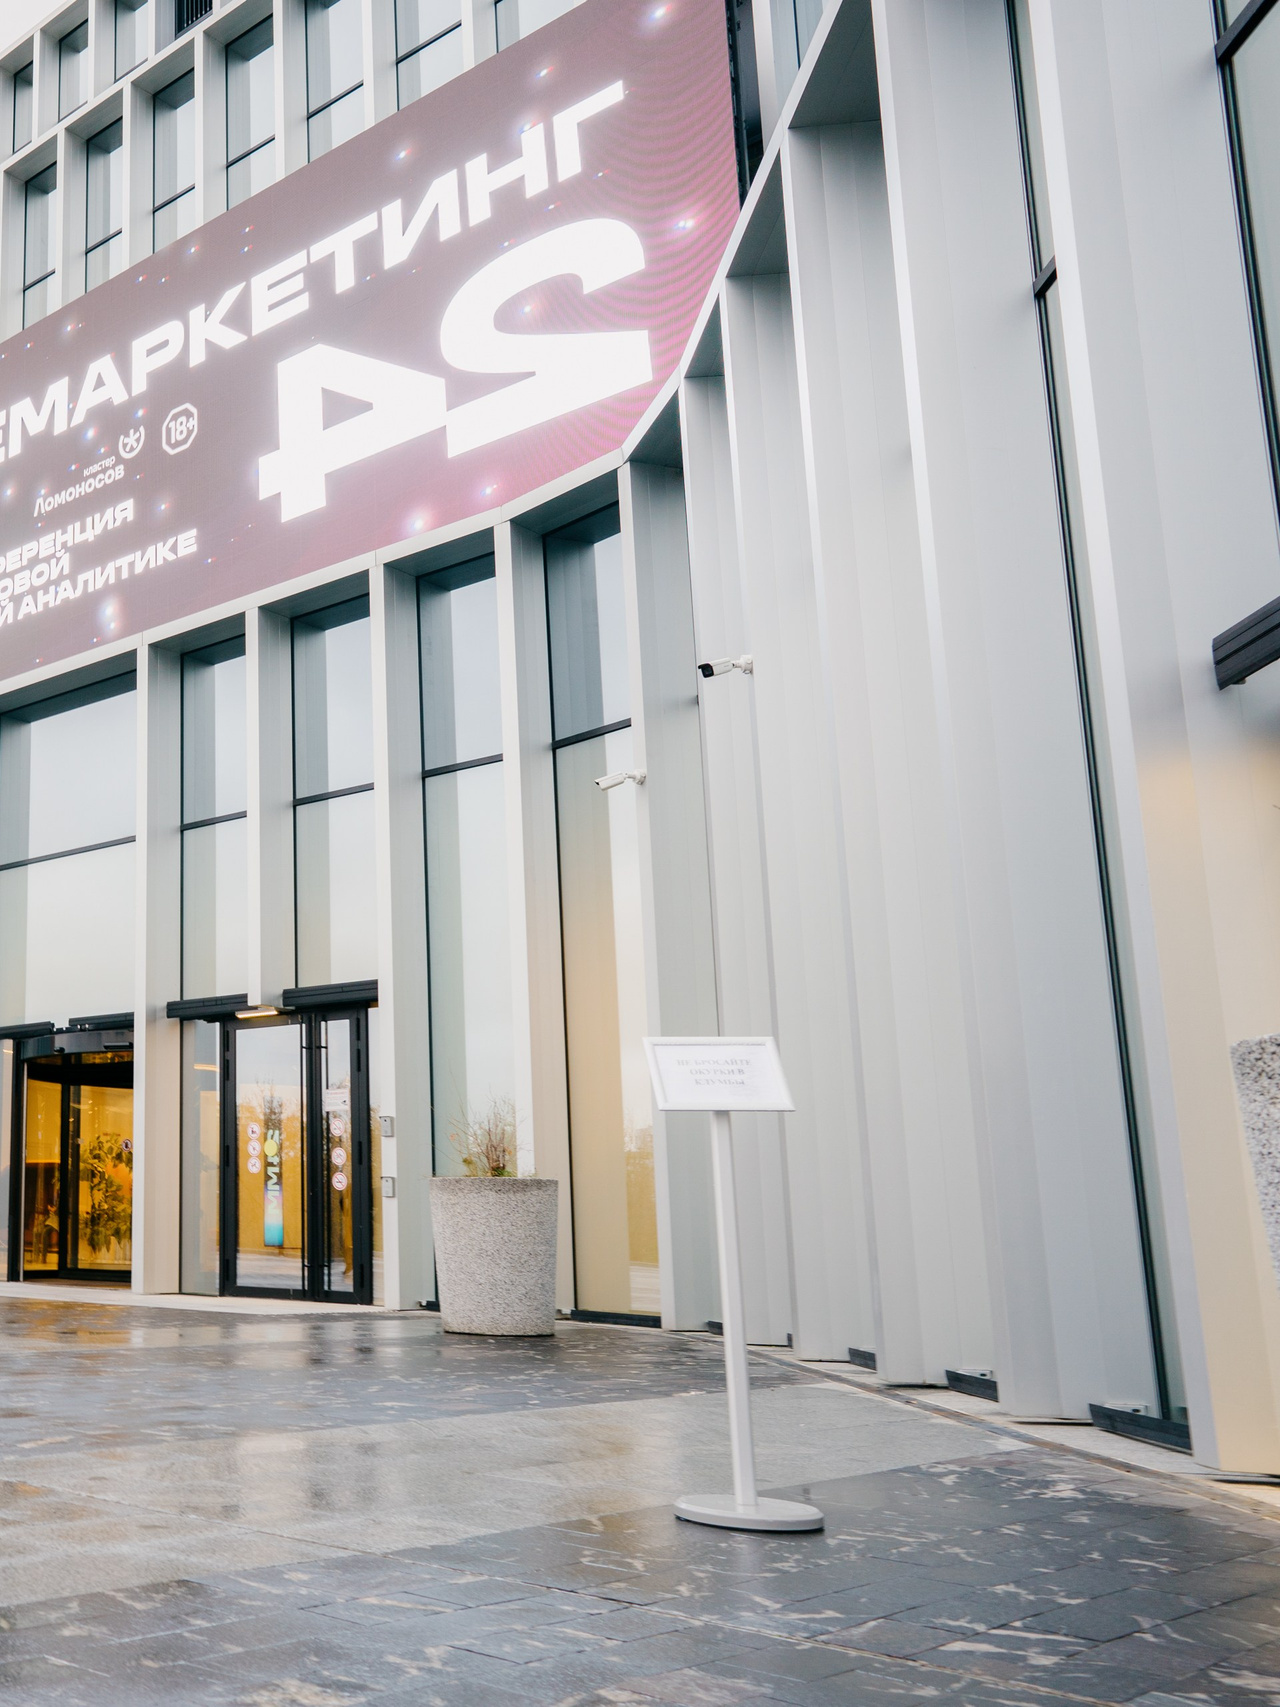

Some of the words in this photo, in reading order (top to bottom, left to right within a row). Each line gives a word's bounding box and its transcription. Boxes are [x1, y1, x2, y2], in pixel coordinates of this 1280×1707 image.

[168, 415, 196, 444] 18+
[83, 455, 116, 478] кластер
[33, 464, 125, 518] Ломоносов
[17, 528, 198, 620] АНАЛИТИКЕ
